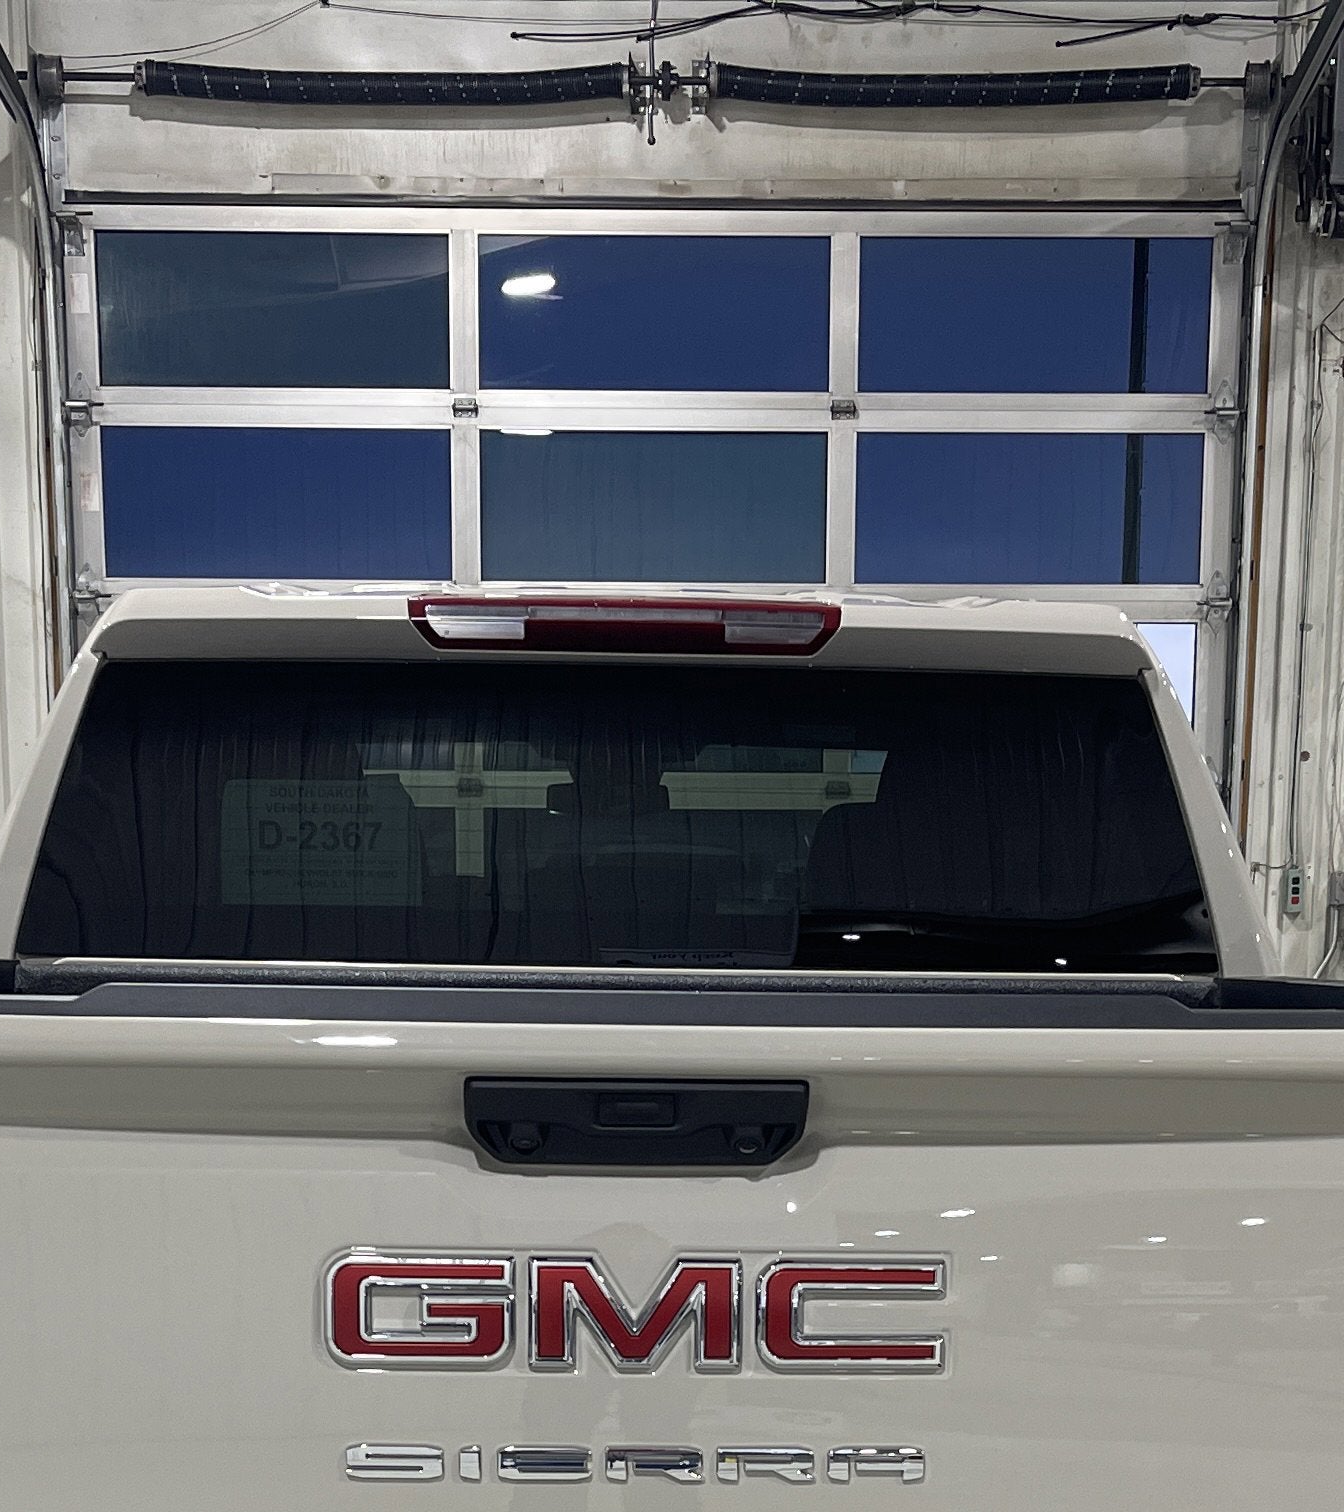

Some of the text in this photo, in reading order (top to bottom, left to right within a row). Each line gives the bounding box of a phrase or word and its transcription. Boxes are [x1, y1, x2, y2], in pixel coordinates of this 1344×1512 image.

[258, 819, 383, 851] D-2367
[327, 1254, 946, 1372] GMC
[345, 1444, 927, 1483] SIERRA
